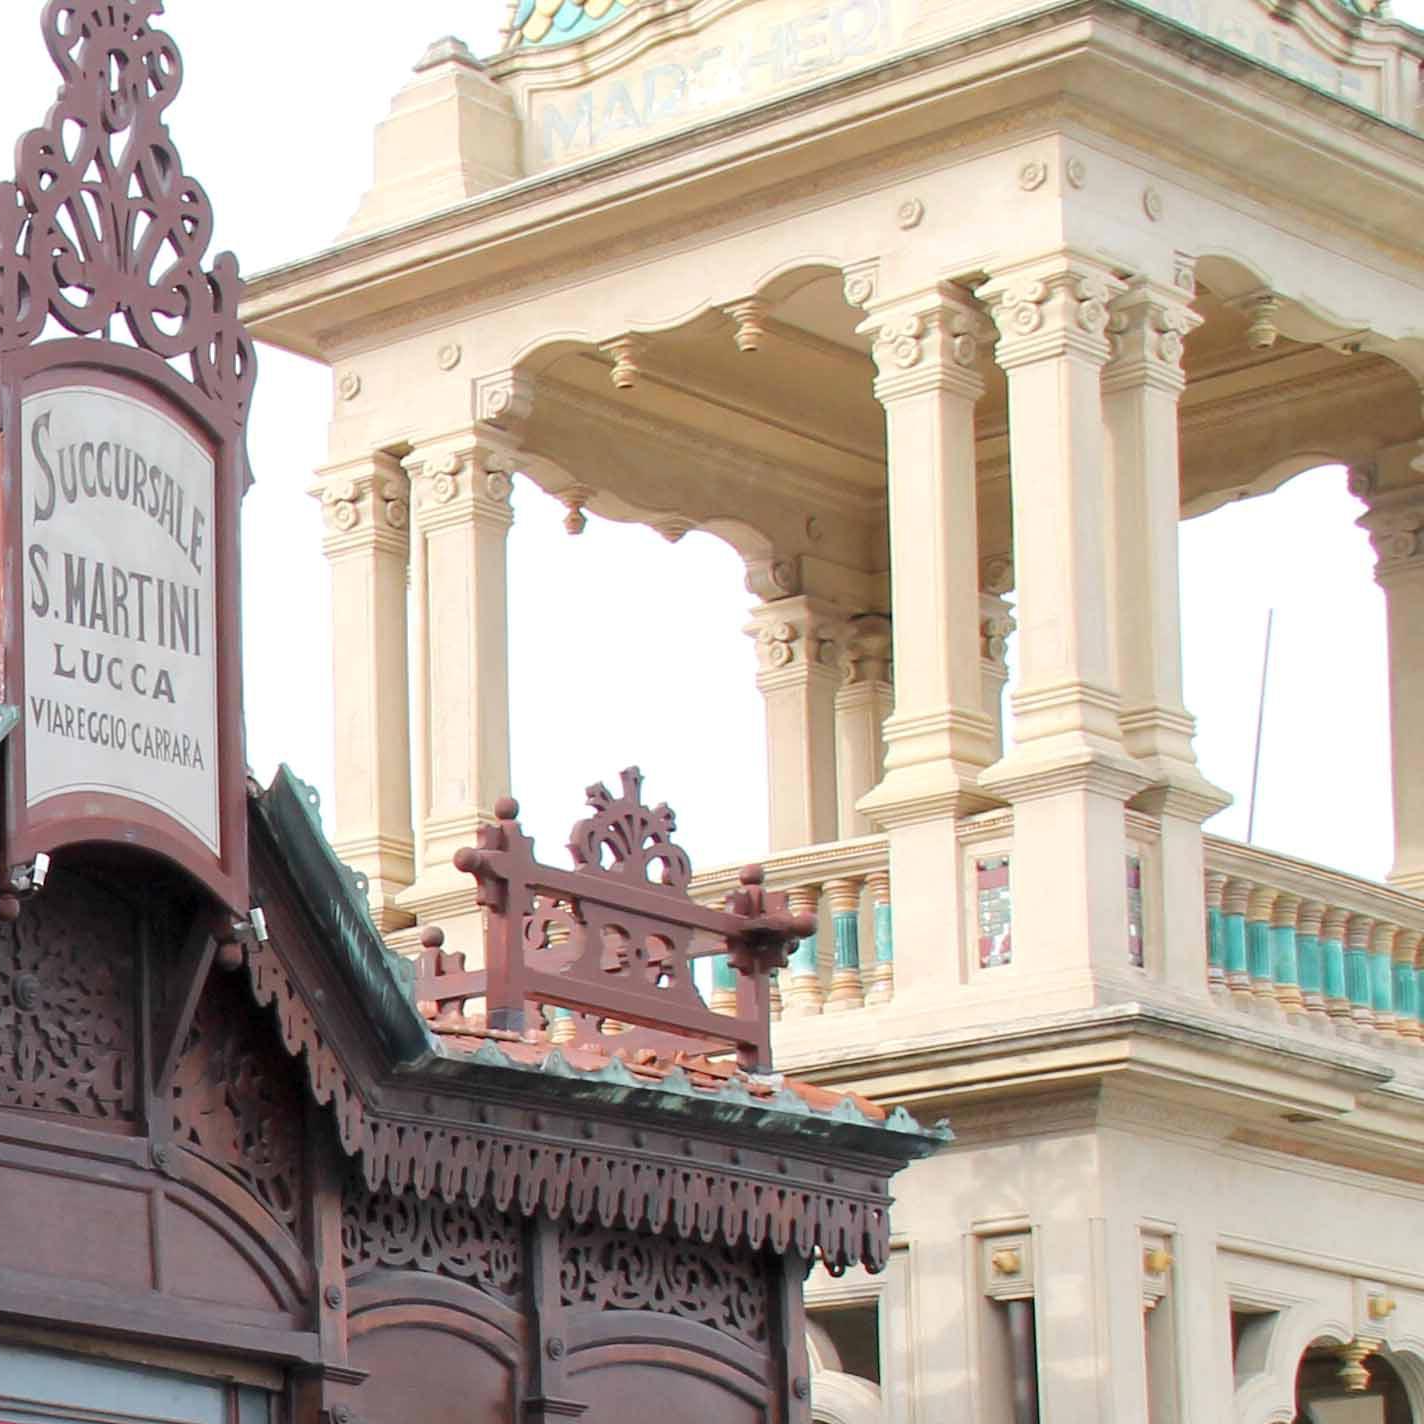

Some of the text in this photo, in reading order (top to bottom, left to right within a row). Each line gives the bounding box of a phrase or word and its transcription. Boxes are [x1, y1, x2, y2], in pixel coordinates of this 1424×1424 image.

[30, 409, 206, 576] SUCCURSALE
[52, 643, 176, 704] LUCCA
[30, 695, 205, 771] VIAREGGIO CARRARA
